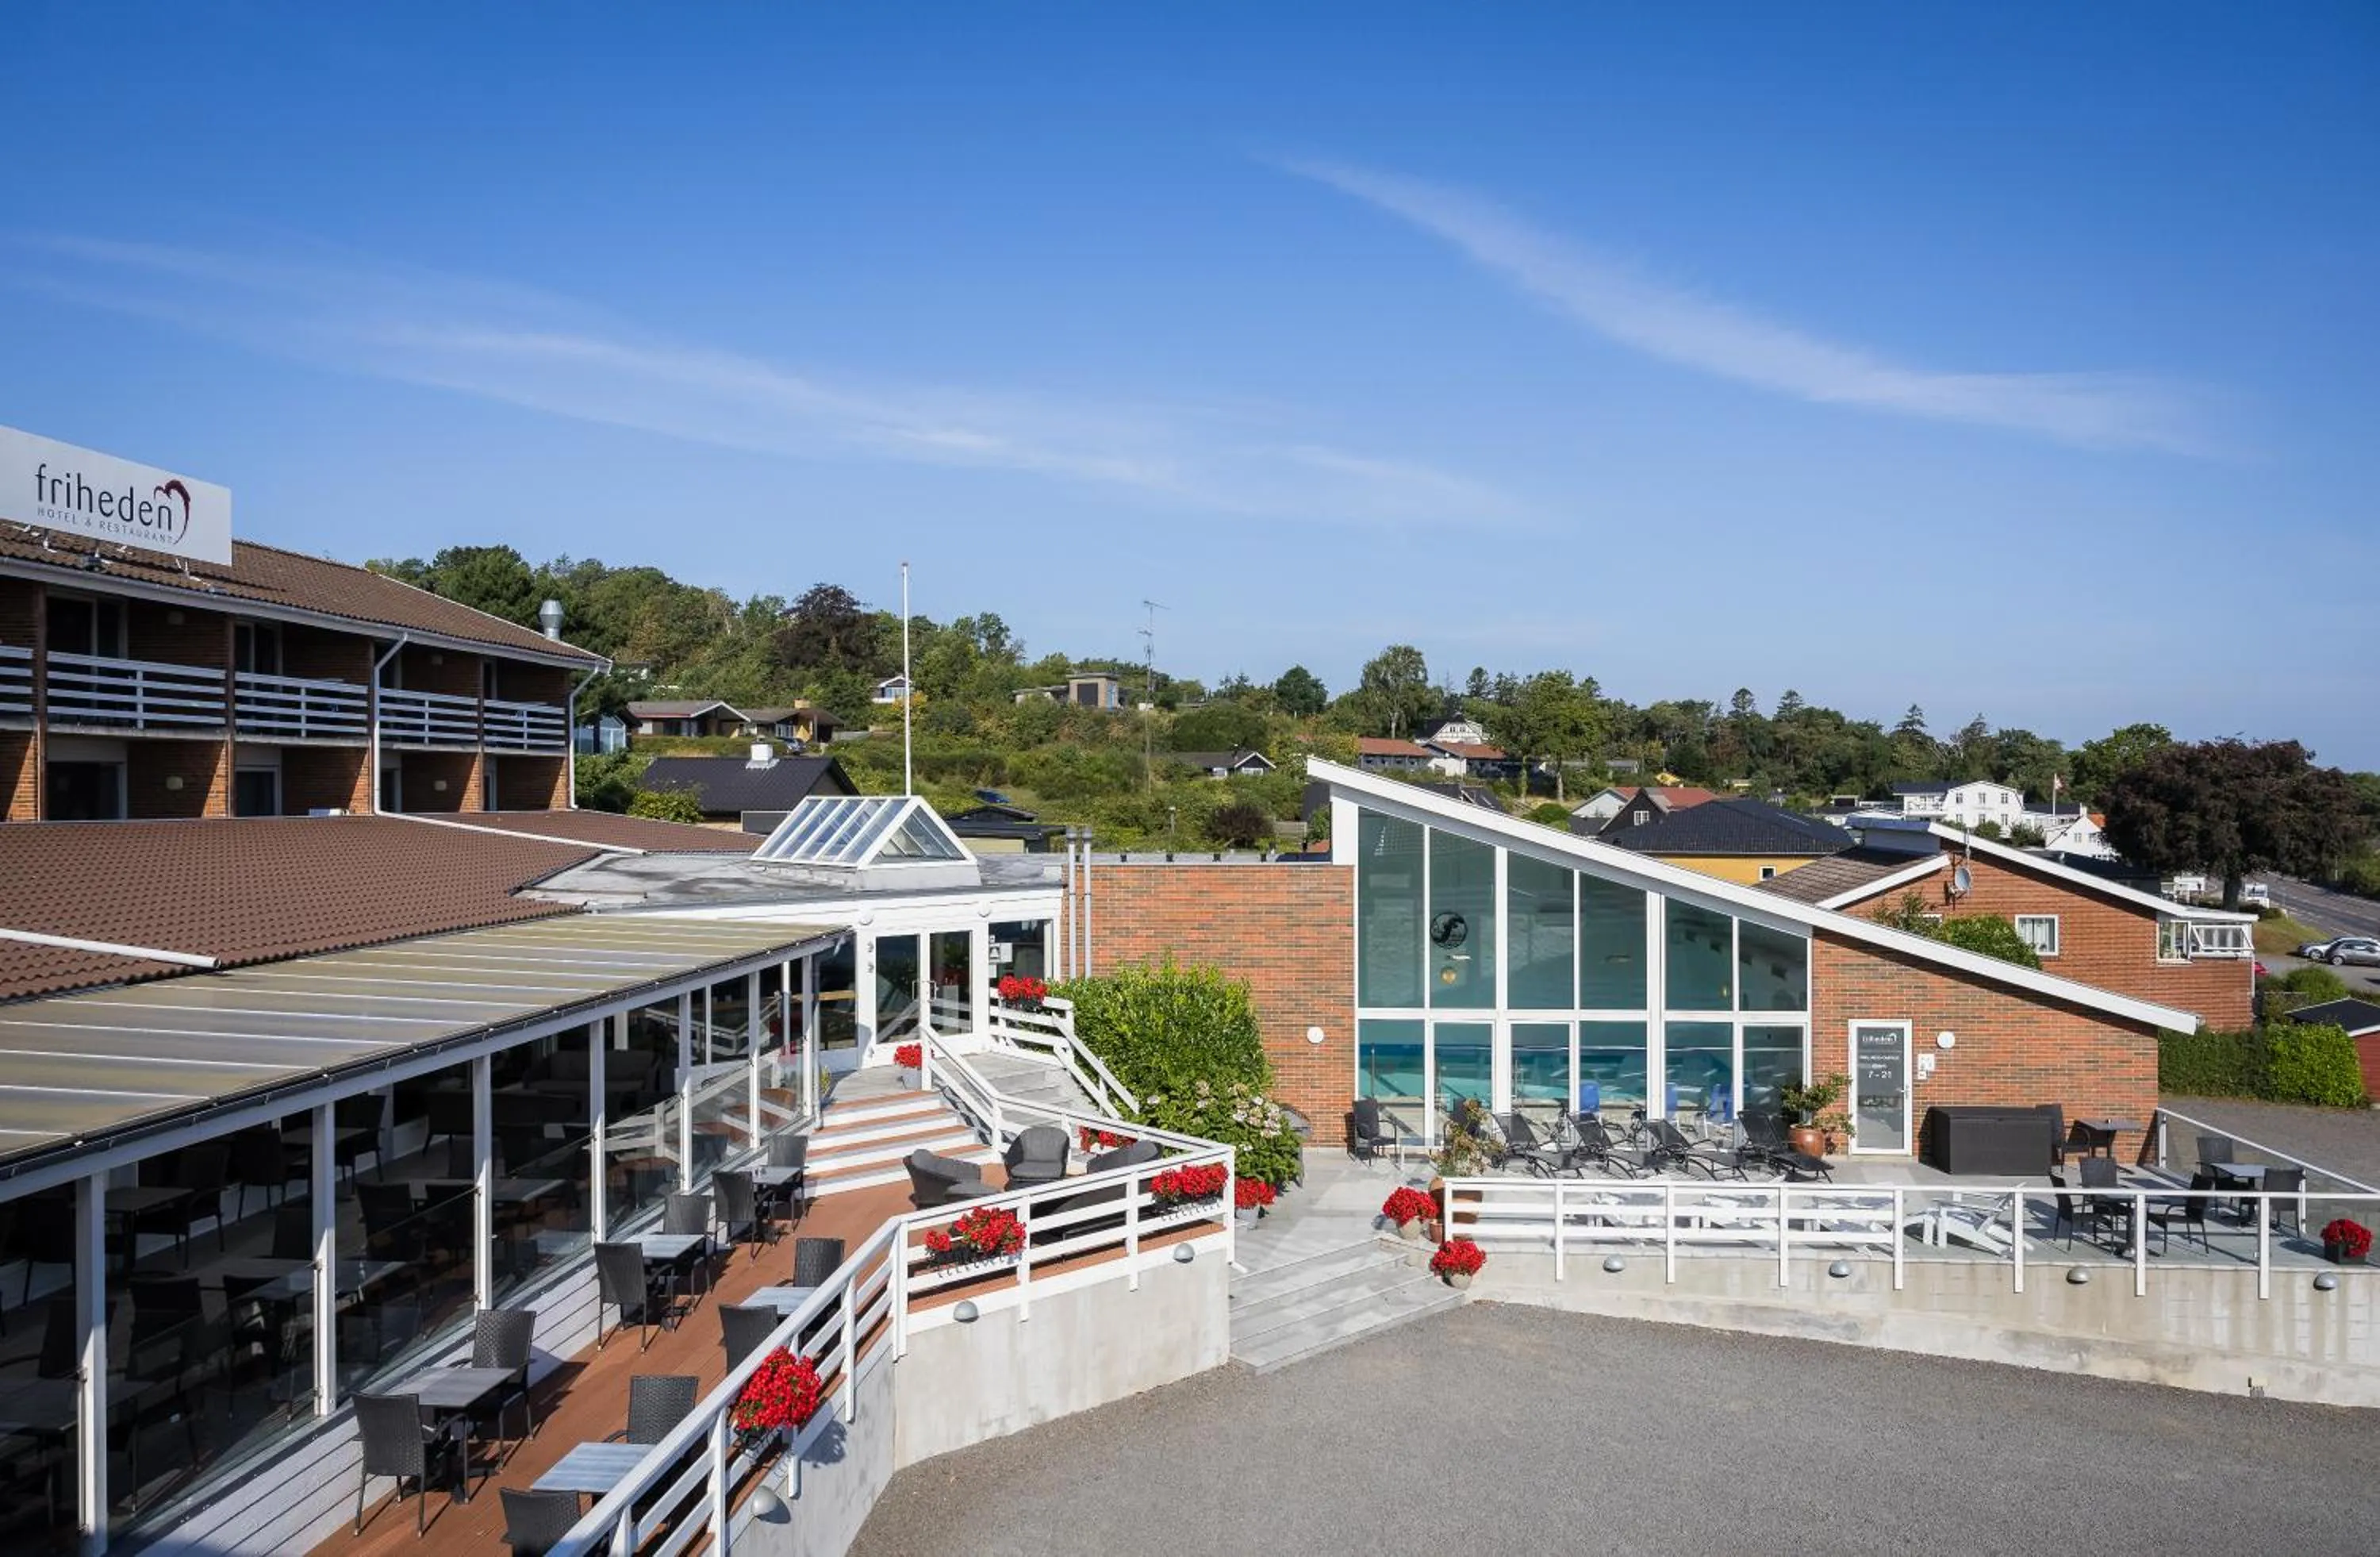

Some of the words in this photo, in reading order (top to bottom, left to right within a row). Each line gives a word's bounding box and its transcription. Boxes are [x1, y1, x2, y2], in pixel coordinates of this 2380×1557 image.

[35, 463, 172, 532] friheden
[37, 507, 77, 525] HOTEL
[84, 517, 92, 528] &
[99, 520, 172, 544] RESTAURANT
